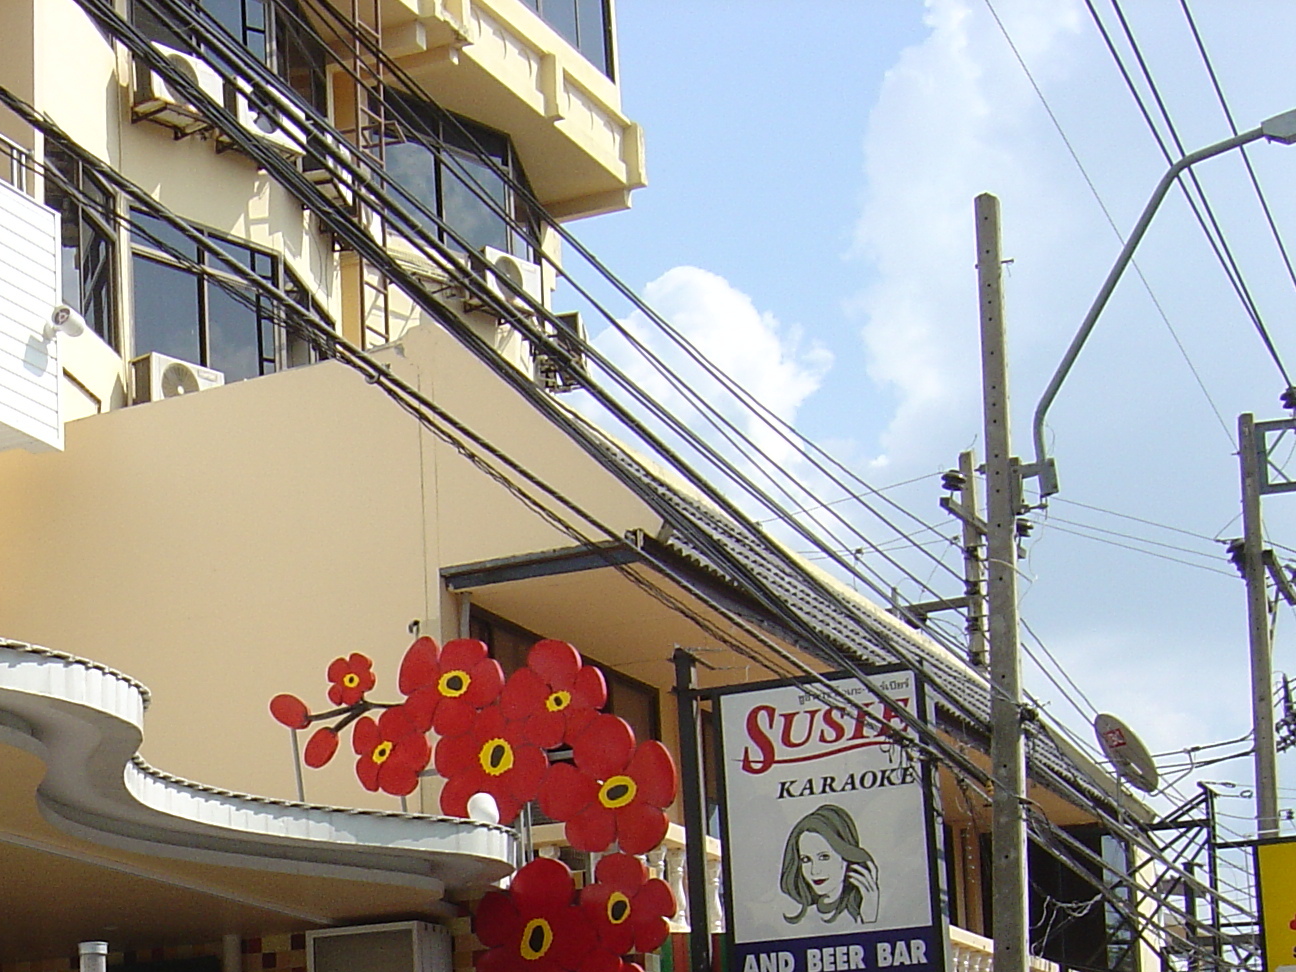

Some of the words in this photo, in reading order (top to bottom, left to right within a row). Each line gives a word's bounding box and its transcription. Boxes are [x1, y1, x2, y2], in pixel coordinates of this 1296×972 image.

[742, 698, 910, 774] SUSIE
[777, 766, 916, 799] KARAOKE
[807, 945, 866, 972] BEER
[877, 939, 928, 967] BAR
